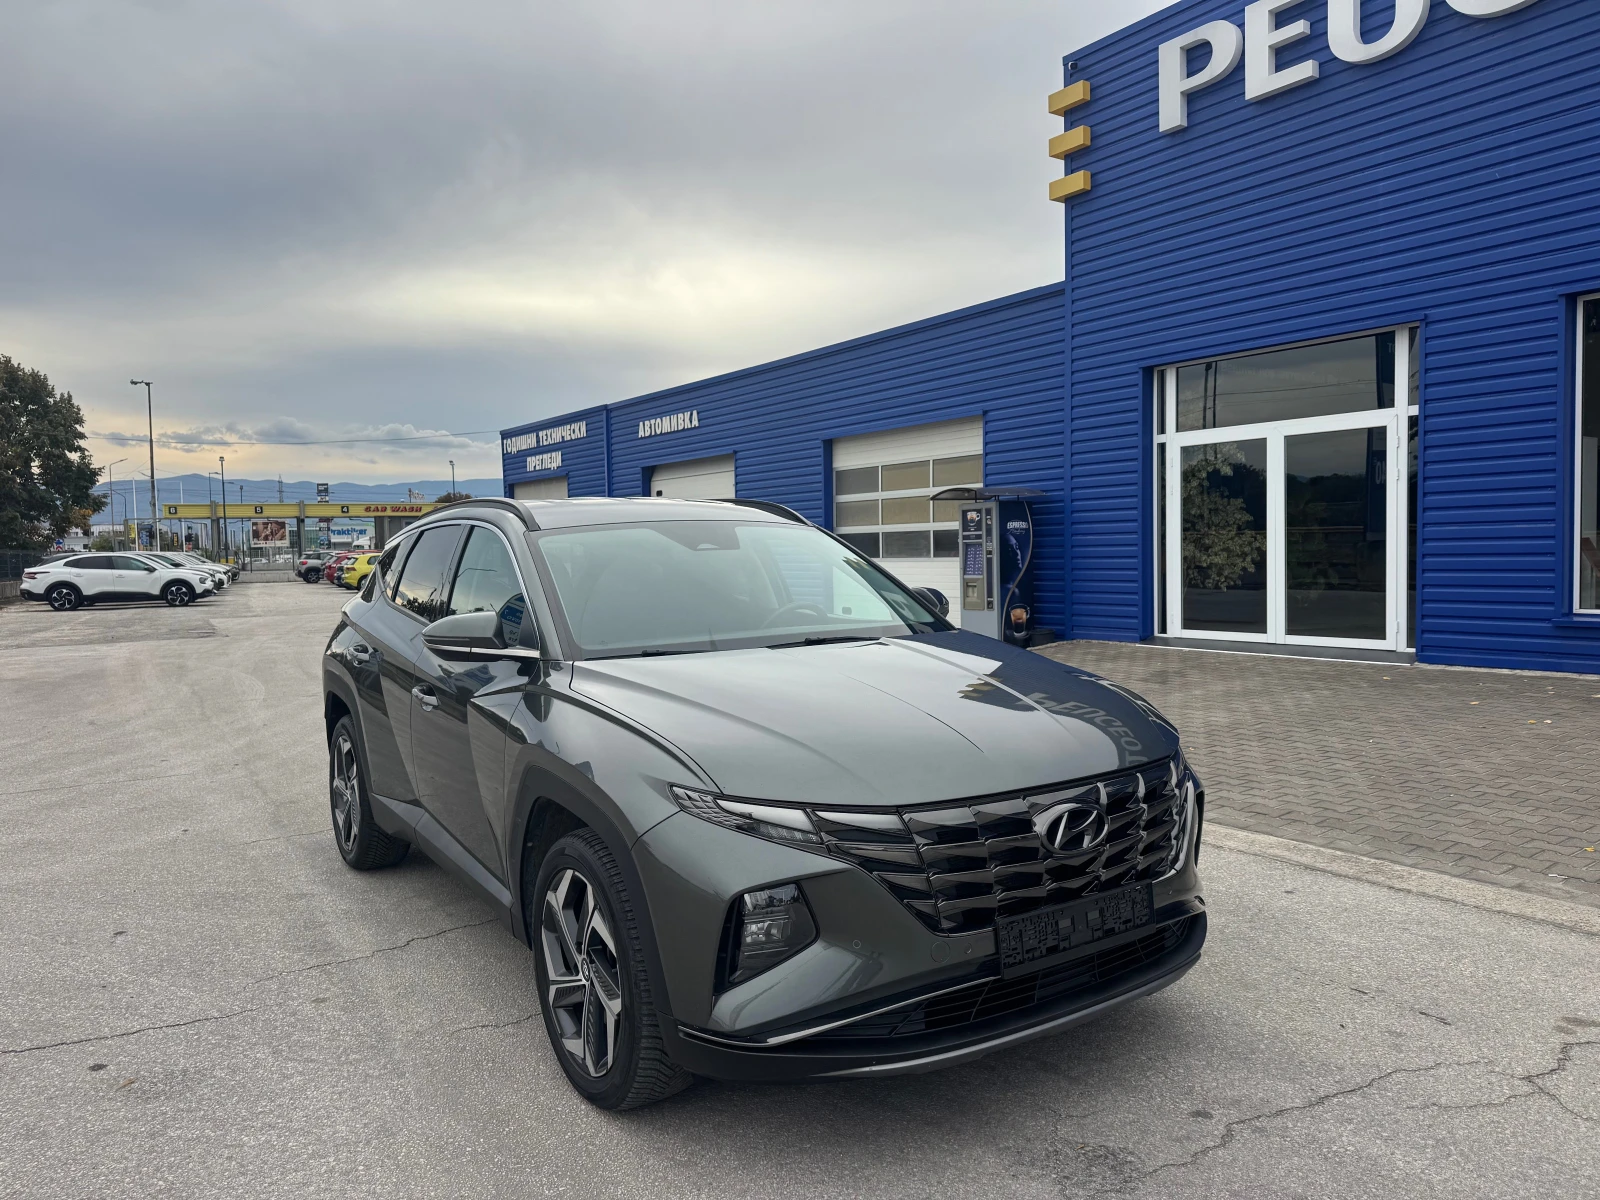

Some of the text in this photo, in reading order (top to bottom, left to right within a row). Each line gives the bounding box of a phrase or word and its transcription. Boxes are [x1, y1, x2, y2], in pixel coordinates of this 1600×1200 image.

[1159, 0, 1543, 133] PEU
[503, 420, 587, 455] ГОДИШНИ ТЕХНИЧЕСКИ
[638, 409, 699, 438] АВТОМИВКА
[526, 450, 562, 472] ПРЕГЛЕДИ
[1007, 521, 1029, 529] ESPRESSO
